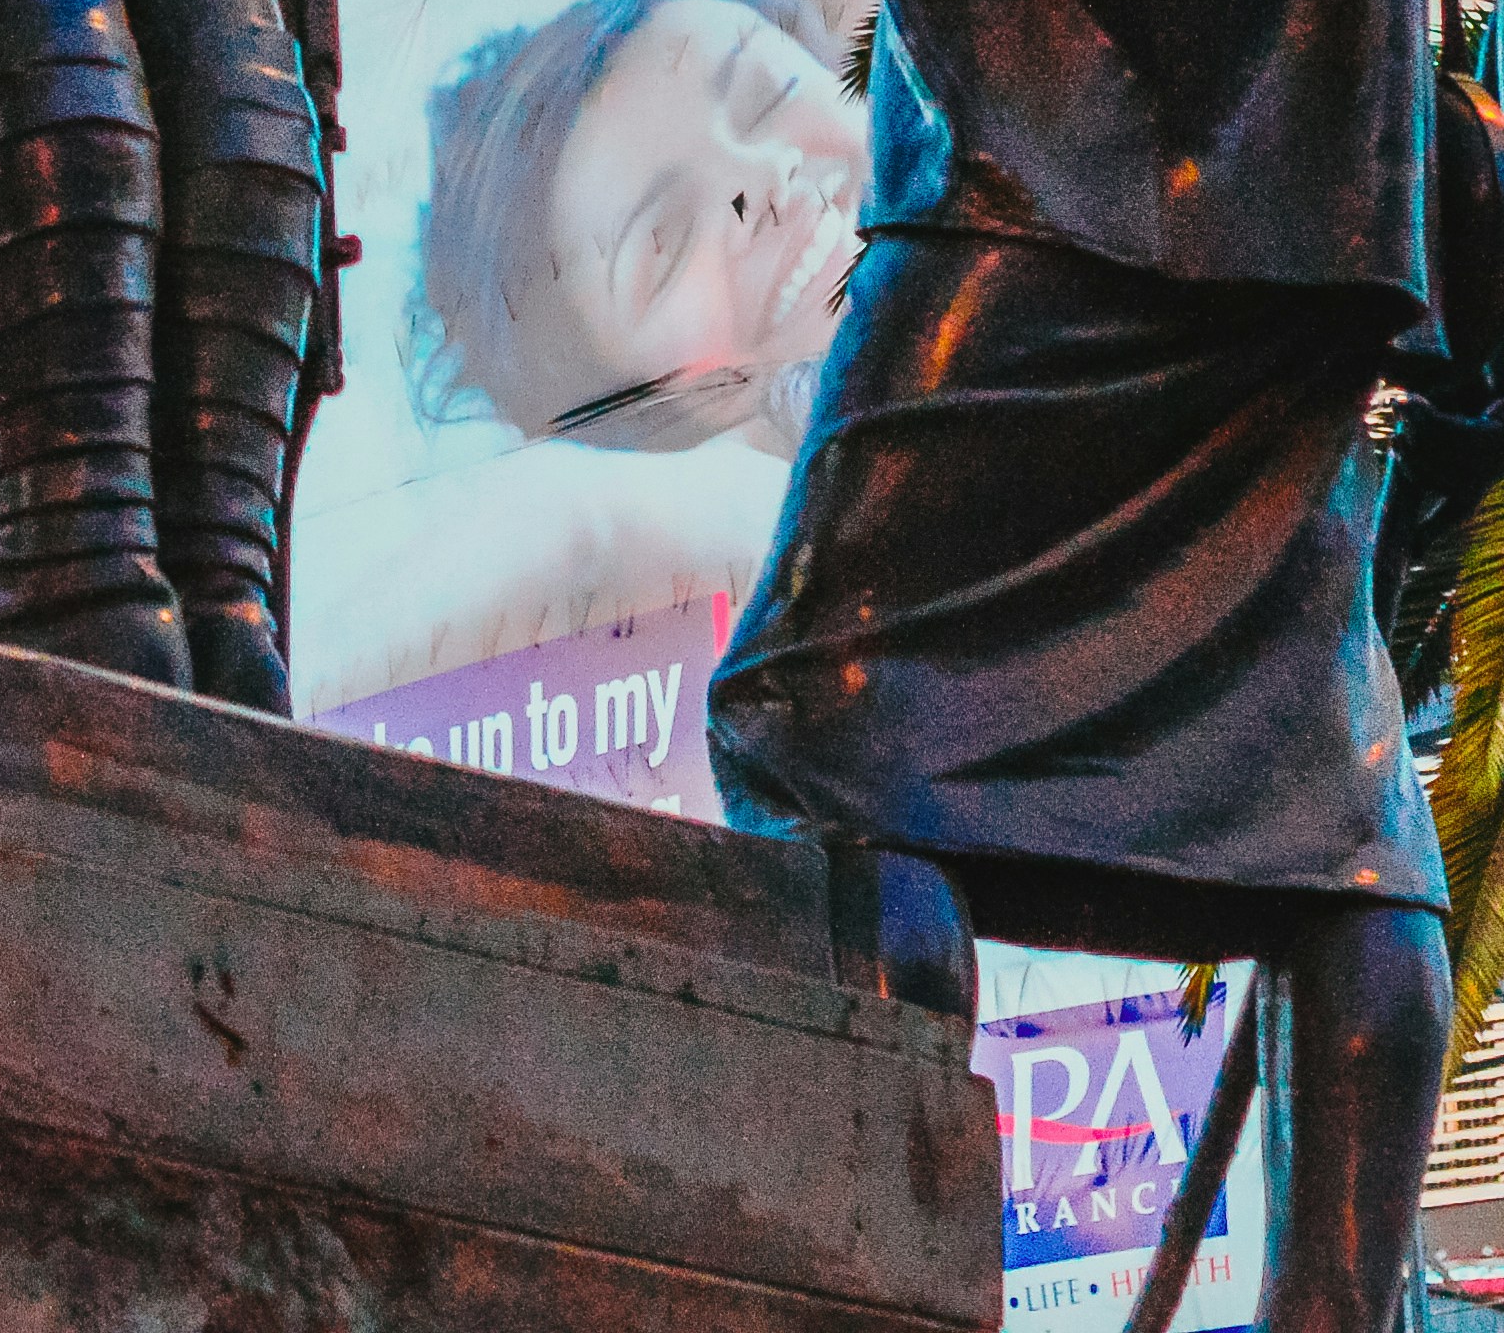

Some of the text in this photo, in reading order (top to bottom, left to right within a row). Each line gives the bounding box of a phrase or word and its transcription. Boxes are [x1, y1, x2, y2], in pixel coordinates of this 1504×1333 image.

[527, 682, 577, 770] to
[595, 663, 682, 767] my
[1025, 1278, 1080, 1312] LIFE
